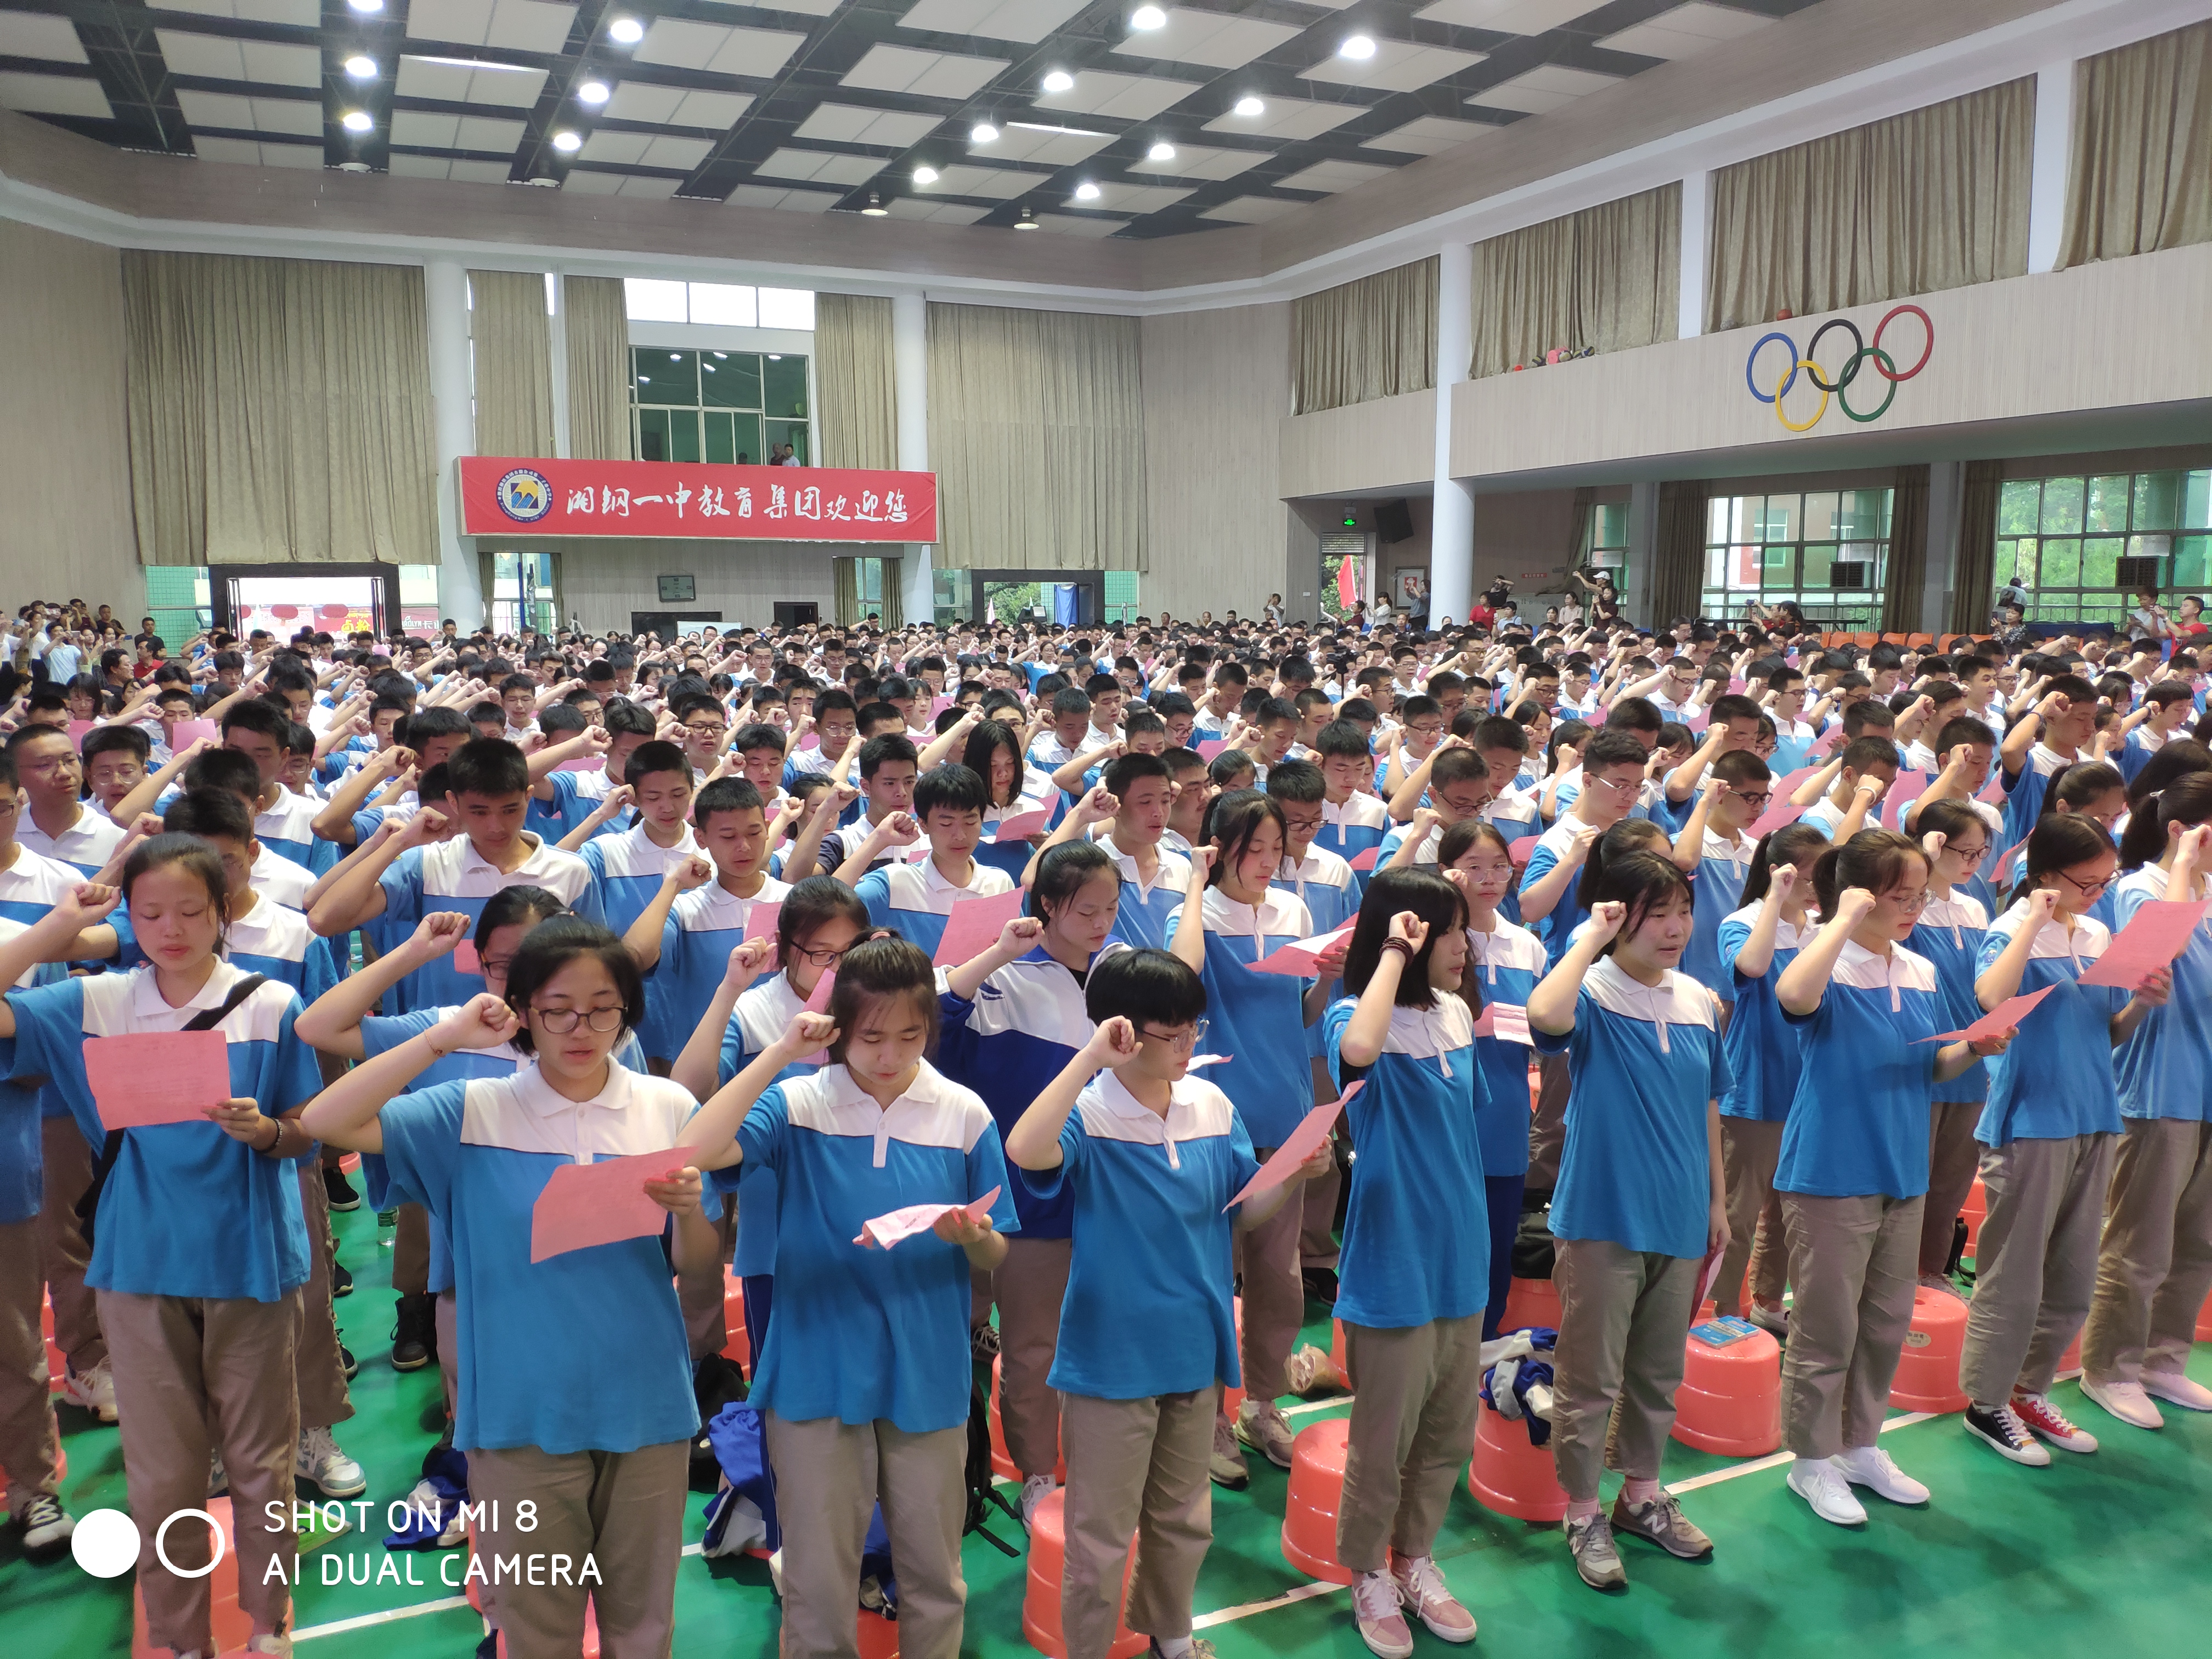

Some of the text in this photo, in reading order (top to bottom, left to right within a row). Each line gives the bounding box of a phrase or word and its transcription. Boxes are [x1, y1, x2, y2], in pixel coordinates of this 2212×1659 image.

[566, 481, 908, 522] 湘钢一中教育集团欢迎您
